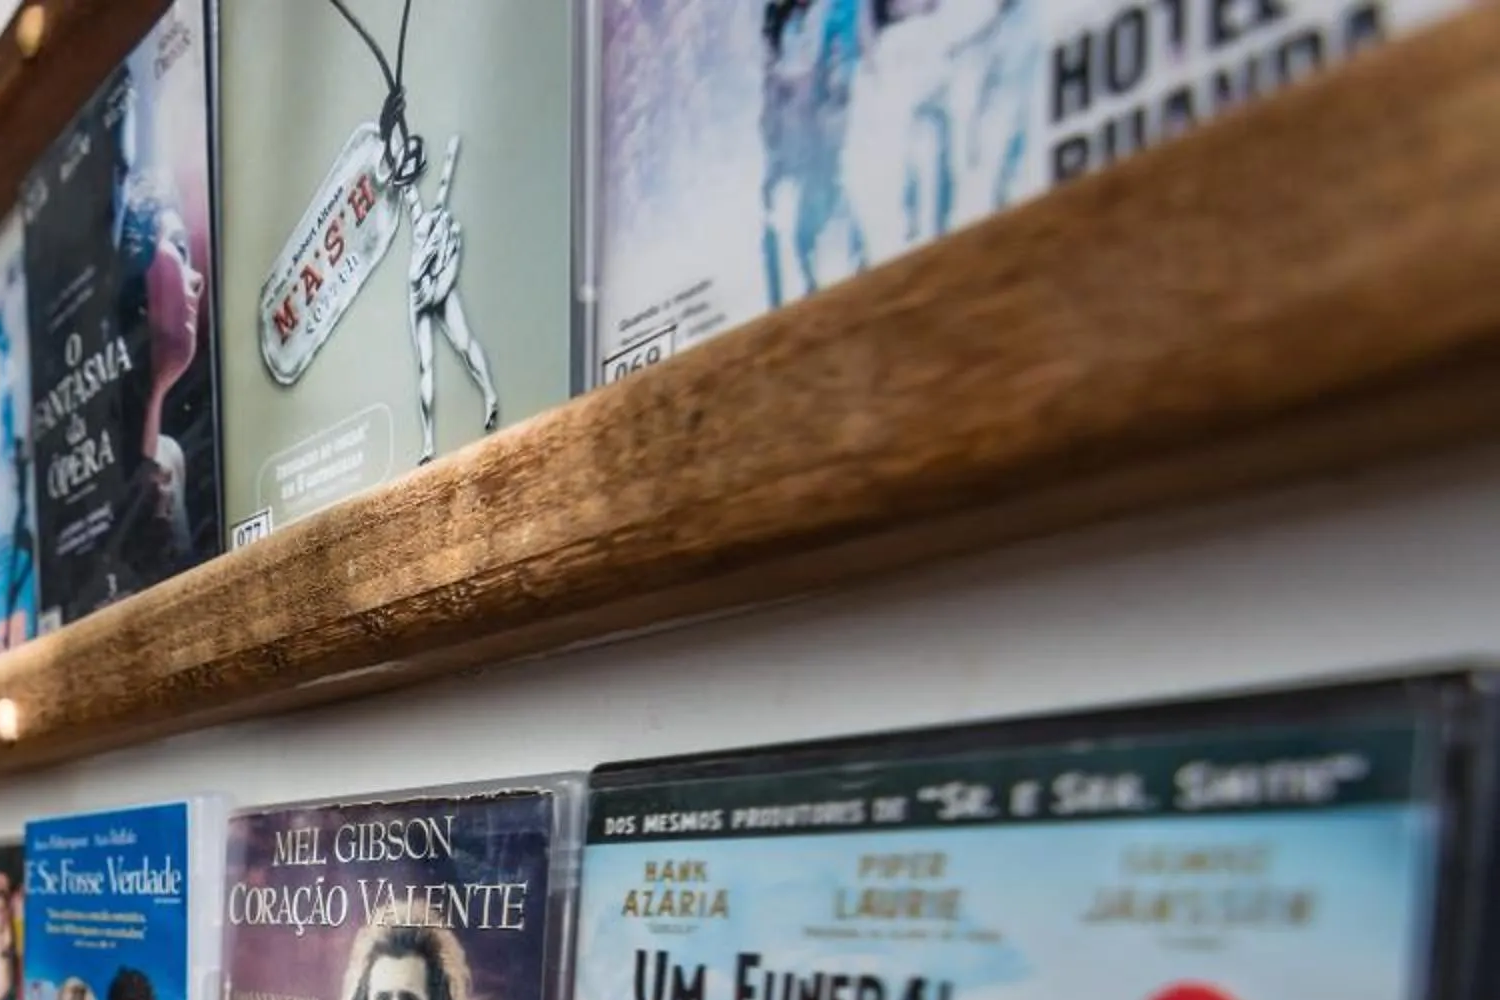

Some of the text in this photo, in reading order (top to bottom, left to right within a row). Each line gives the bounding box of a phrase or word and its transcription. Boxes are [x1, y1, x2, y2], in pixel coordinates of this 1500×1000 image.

[1053, 0, 1288, 124] HOTE
[64, 333, 83, 367] O
[605, 816, 636, 836] DOS
[642, 808, 725, 836] MESMOS
[731, 799, 866, 830] PRODUTORES
[272, 815, 456, 867] MEL GIBSON
[23, 859, 37, 895] E
[60, 857, 105, 896] Fosse
[106, 854, 182, 896] Verdade
[643, 859, 709, 883] HANK
[357, 876, 529, 932] VALENTE
[621, 888, 730, 919] AZARIA
